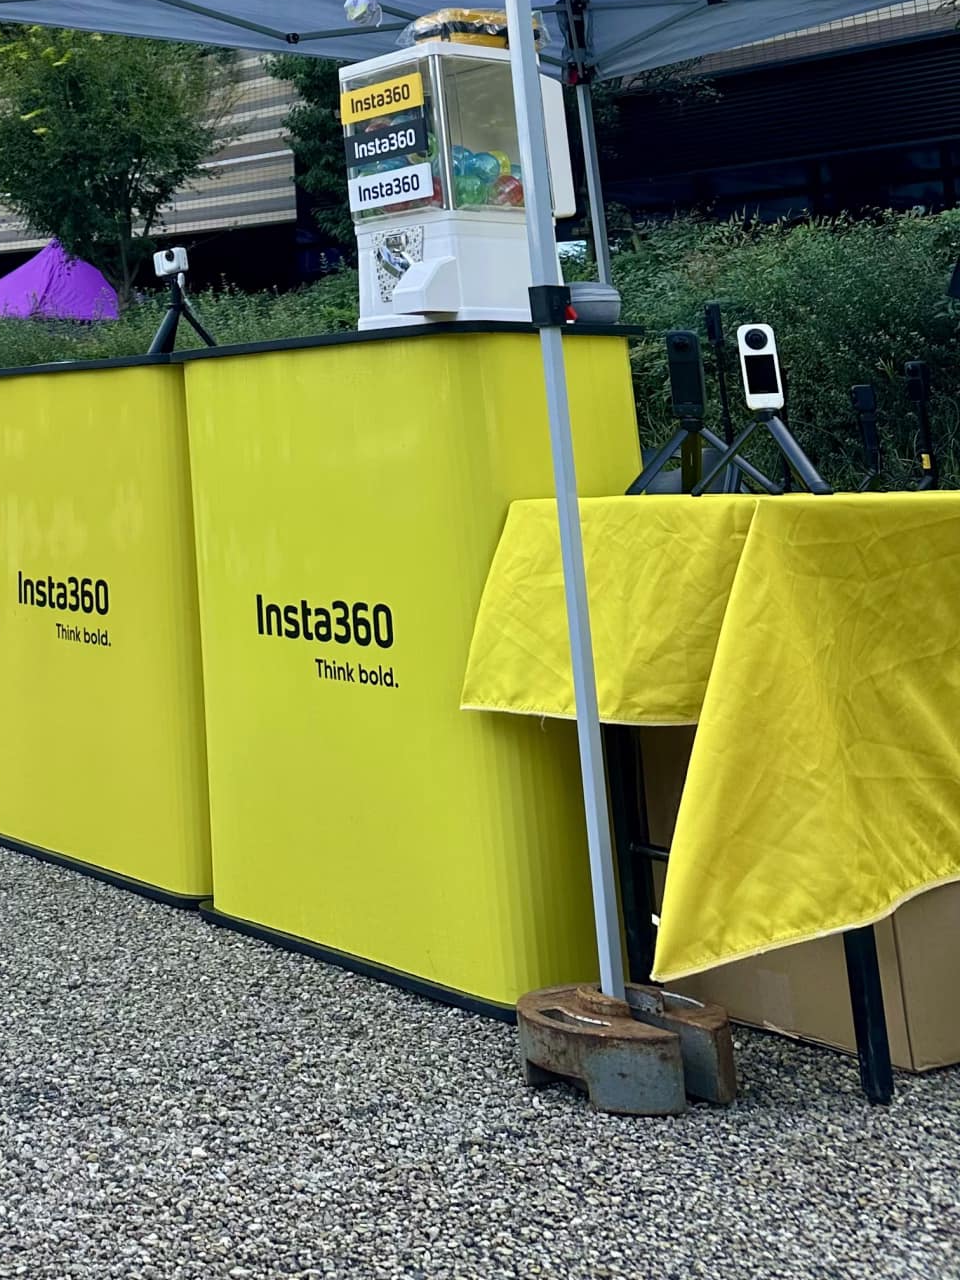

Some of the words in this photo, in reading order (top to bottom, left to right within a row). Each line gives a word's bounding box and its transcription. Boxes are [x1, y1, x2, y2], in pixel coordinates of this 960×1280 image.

[350, 83, 410, 114] Insta360
[354, 128, 416, 159] Insta360
[358, 173, 420, 202] Insta360
[17, 570, 110, 616] Insta360
[55, 622, 81, 644] Think
[83, 626, 112, 647] bold.
[255, 594, 394, 649] Insta360
[314, 658, 355, 683] Think
[358, 664, 399, 689] bold.
